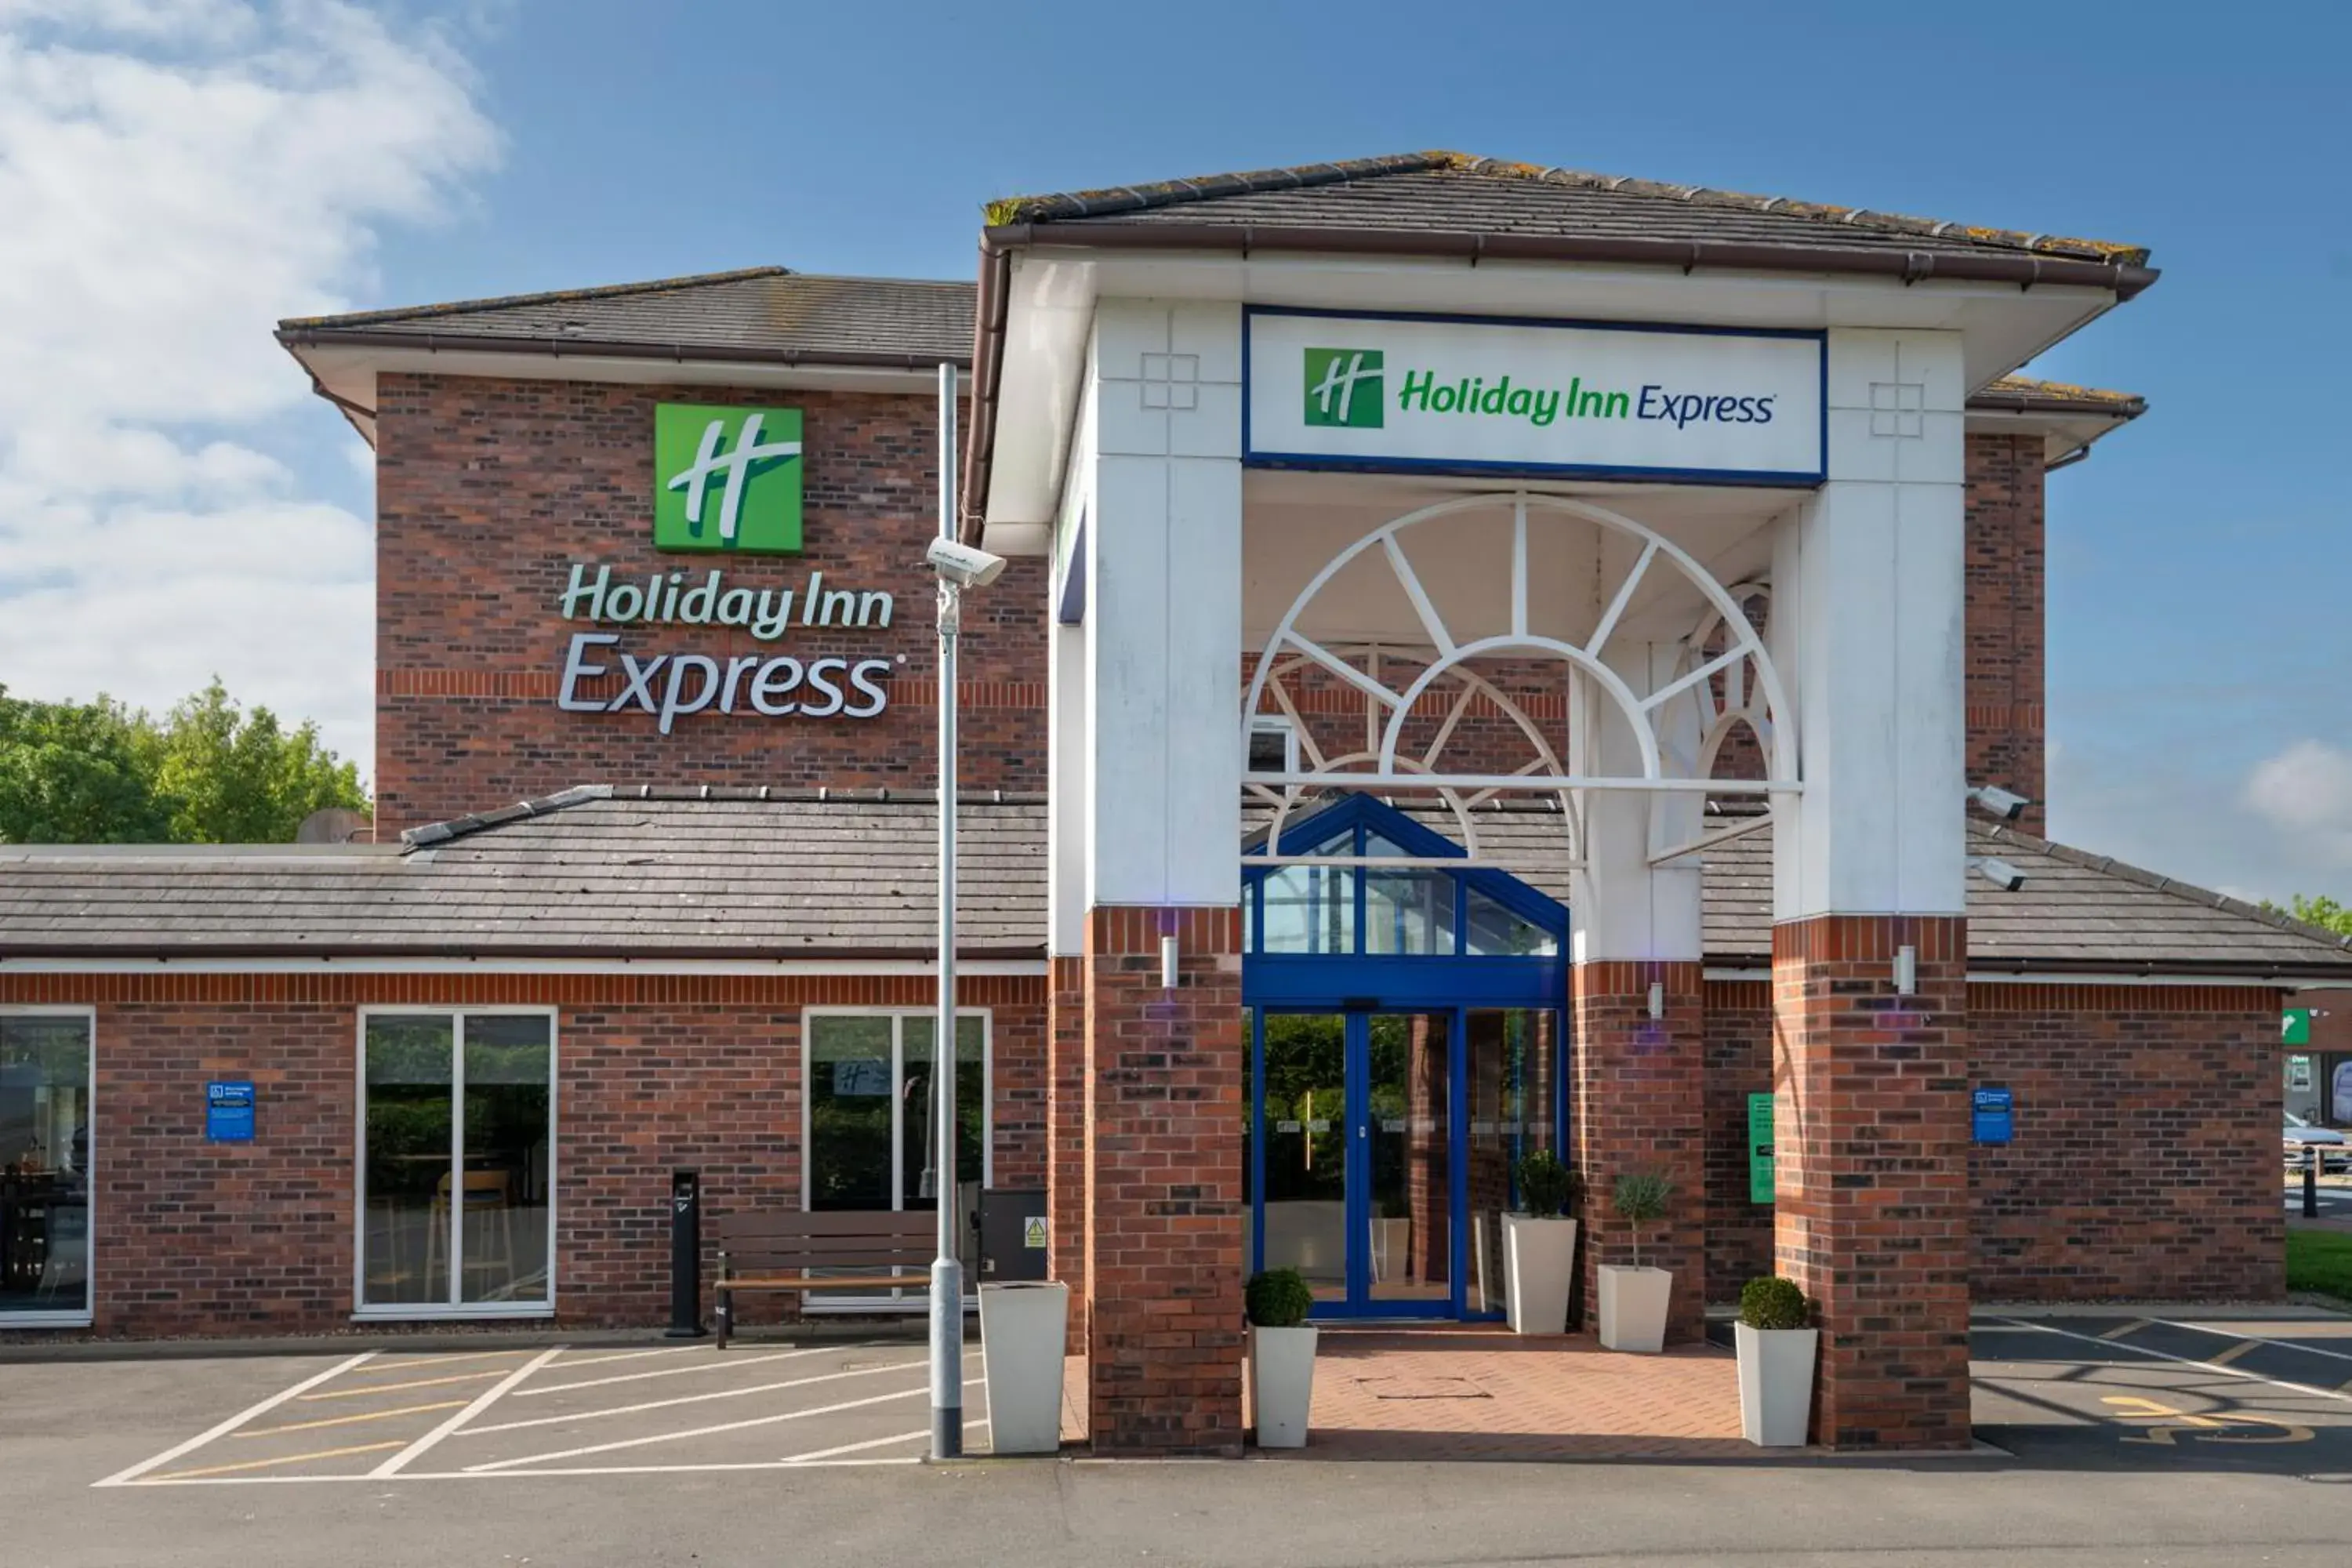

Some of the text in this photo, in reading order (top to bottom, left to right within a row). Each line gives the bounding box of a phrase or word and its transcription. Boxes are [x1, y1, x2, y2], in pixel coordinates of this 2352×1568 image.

[1399, 370, 1773, 430] Holiday Inn Express
[558, 564, 894, 641] Holiday Inn
[557, 633, 891, 735] Express
